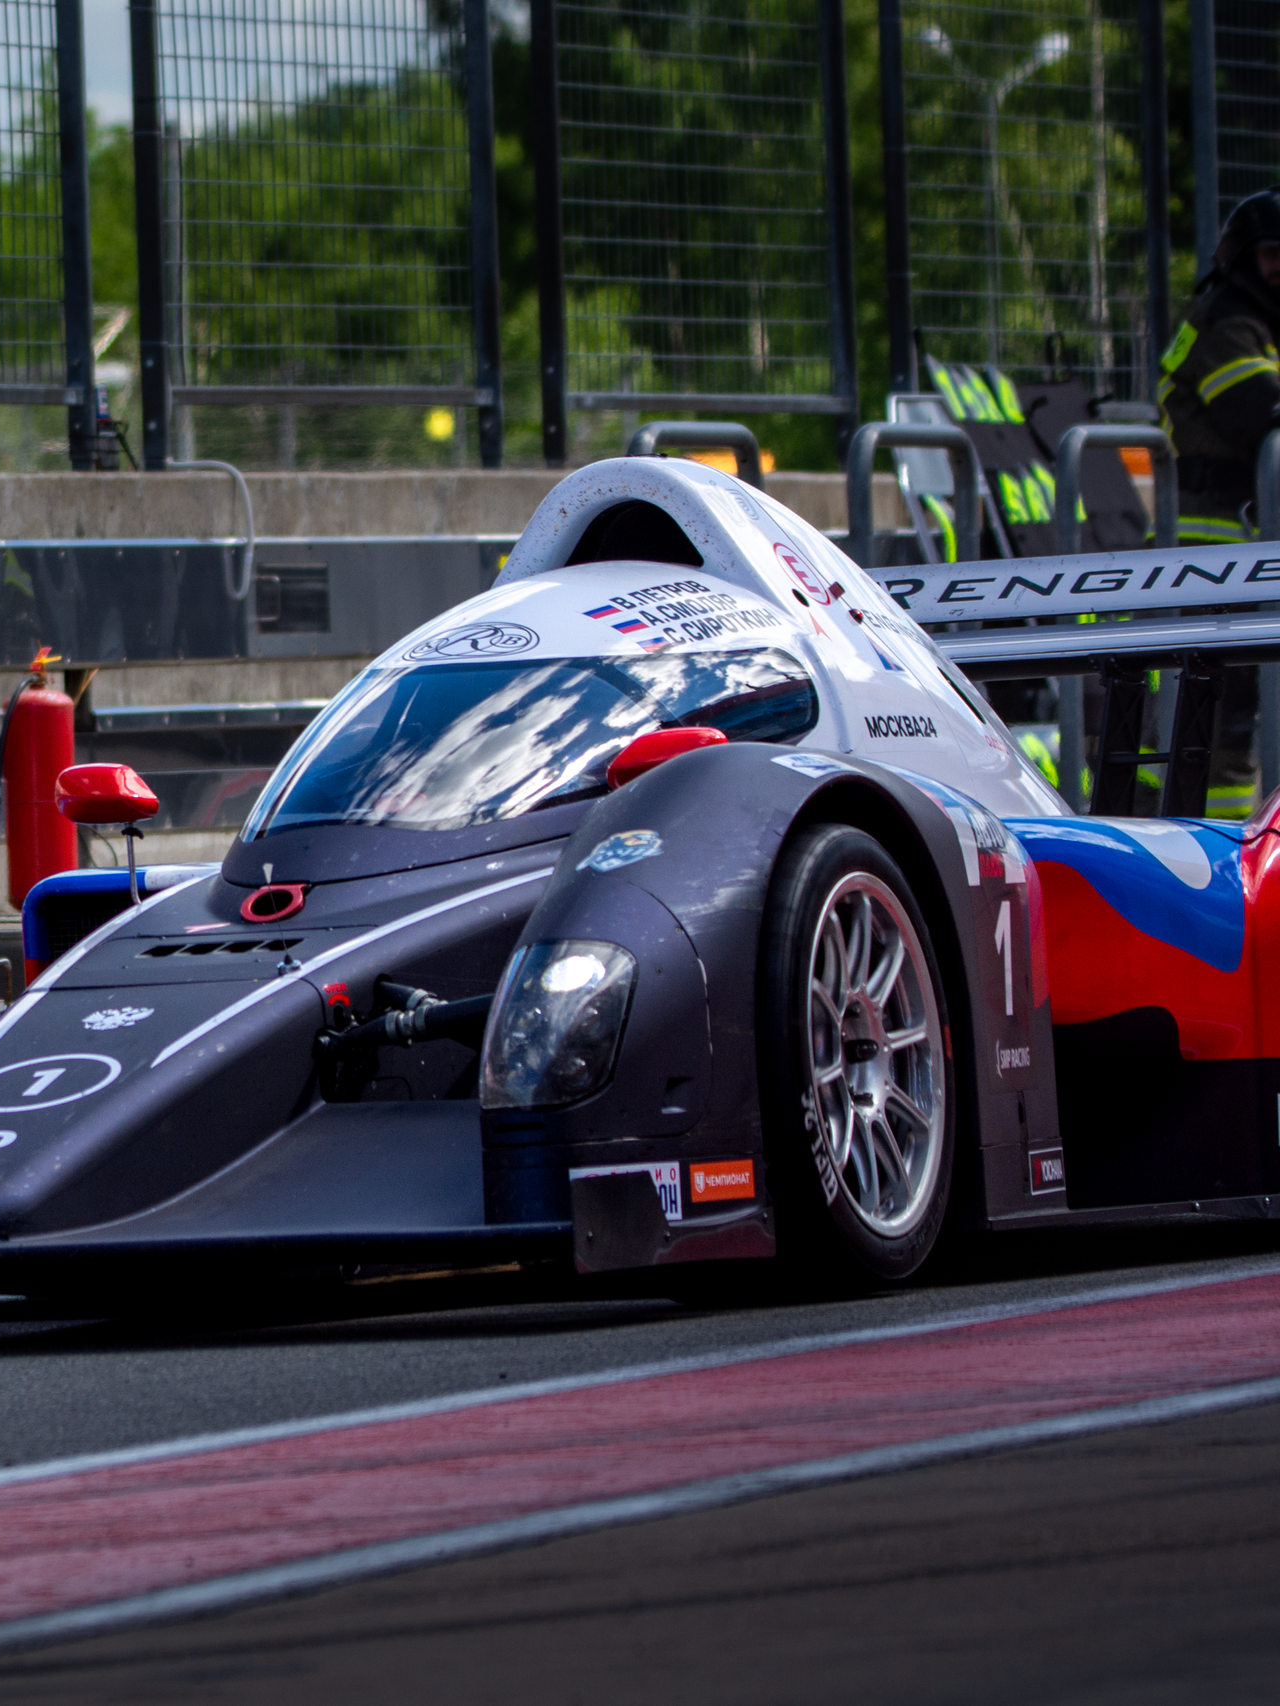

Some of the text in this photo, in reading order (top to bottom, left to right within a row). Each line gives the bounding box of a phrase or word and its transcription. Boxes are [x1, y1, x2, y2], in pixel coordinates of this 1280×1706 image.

[608, 580, 711, 610] В.ПЕТРОВ
[662, 608, 783, 645] С.СИРОТКИН
[864, 715, 938, 738] МОСКВА24
[994, 900, 1014, 1016] 1
[22, 1067, 67, 1097] 1
[705, 1172, 750, 1188] ЧЕМПИОНАТ
